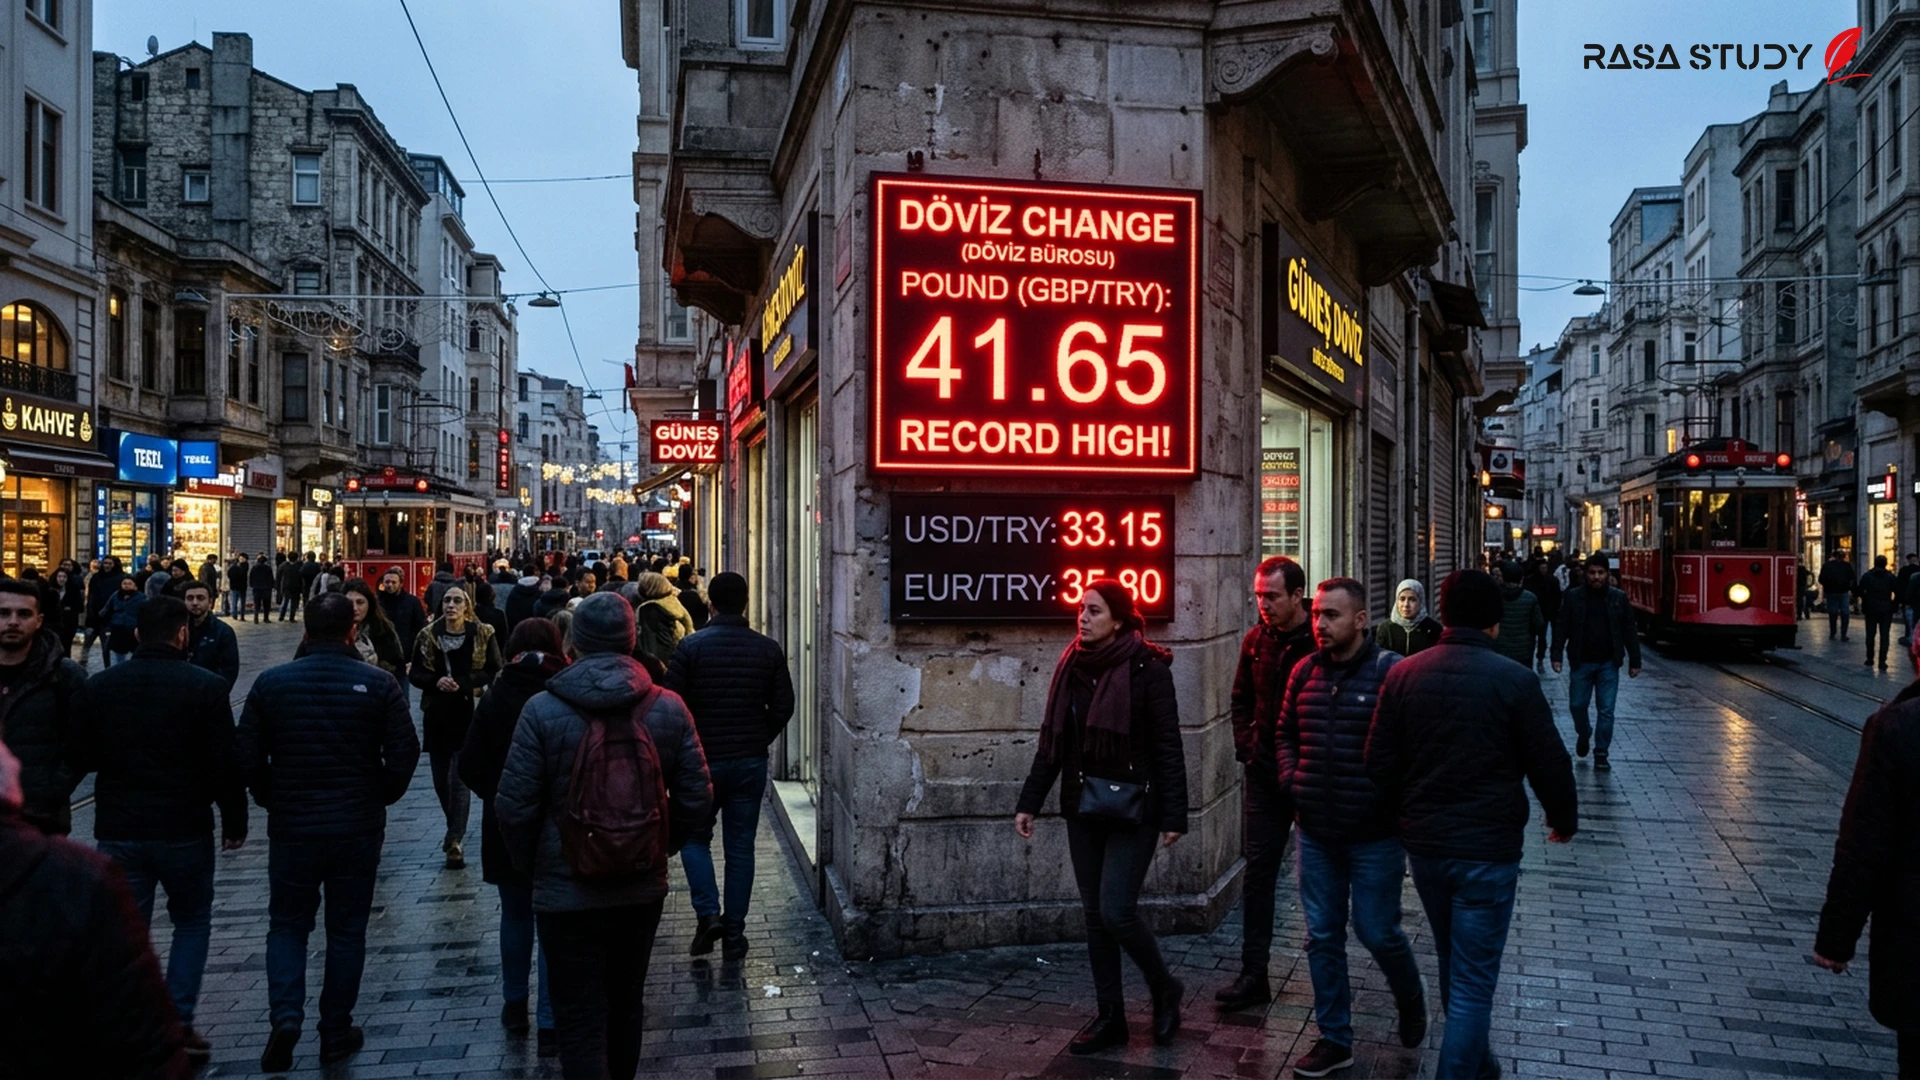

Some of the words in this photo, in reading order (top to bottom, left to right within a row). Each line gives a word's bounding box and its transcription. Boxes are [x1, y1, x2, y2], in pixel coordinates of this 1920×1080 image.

[900, 194, 1012, 235] DÖVİZ
[1022, 205, 1175, 243] CHANGE
[961, 241, 1025, 263] (DÖVİZ
[1031, 243, 1115, 270] BÜROSU)
[901, 271, 1009, 300] POUND
[1018, 276, 1172, 313] (GBP/TRY):
[905, 315, 1167, 406] 41.65
[21, 404, 75, 438] KAHVE
[900, 419, 1060, 454] RECORD
[1072, 424, 1171, 457] HIGH!
[904, 515, 1057, 544] USD/TRY:
[1062, 511, 1162, 547] 33.15
[904, 573, 1057, 601] EUR/TRY:
